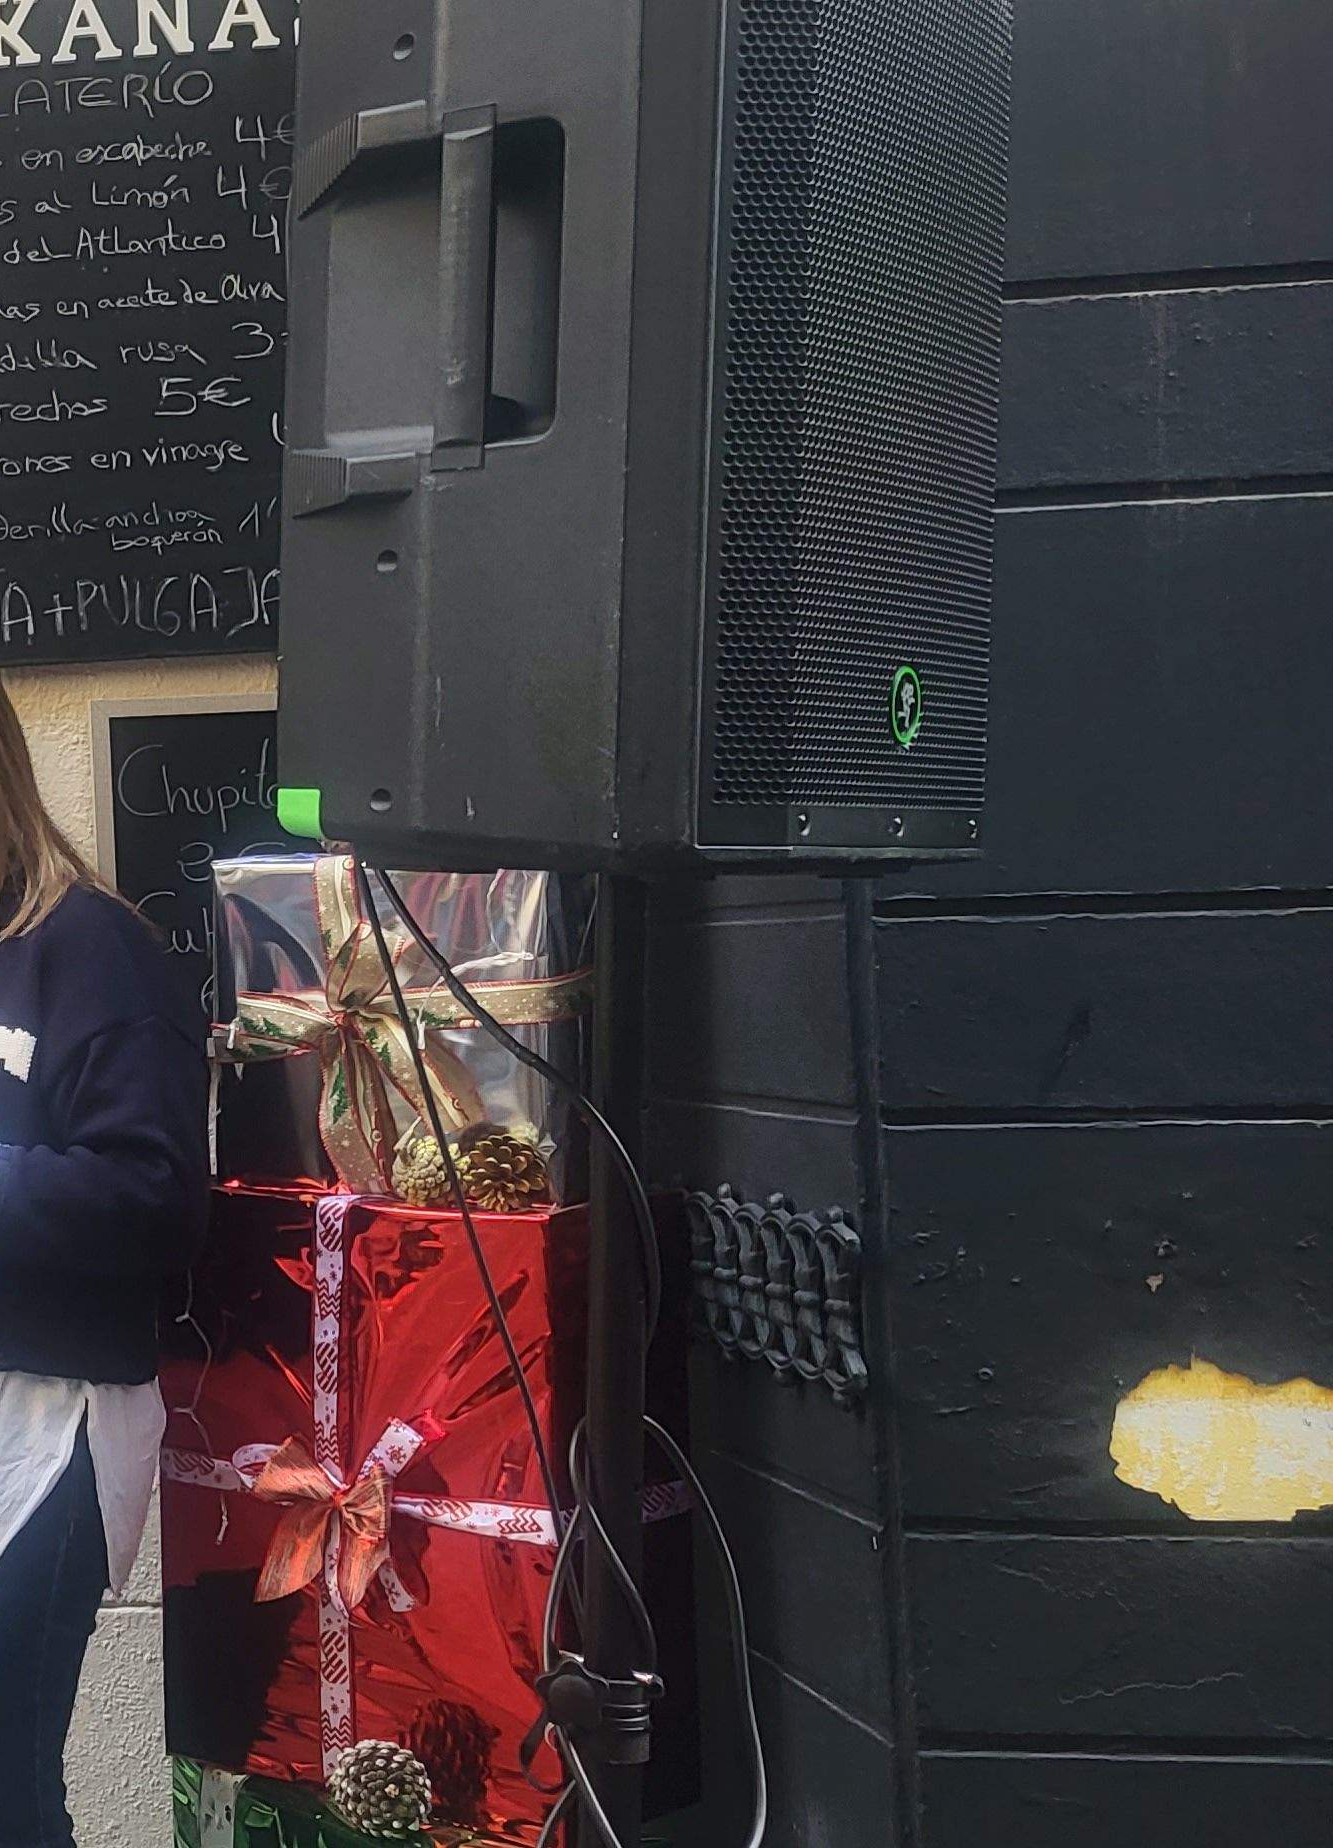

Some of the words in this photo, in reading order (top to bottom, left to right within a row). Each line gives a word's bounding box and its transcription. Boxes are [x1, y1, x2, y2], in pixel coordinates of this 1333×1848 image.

[22, 150, 64, 171] en
[75, 132, 212, 166] escabeche
[35, 190, 72, 214] al
[92, 174, 190, 208] Limón
[4, 237, 74, 265] del
[56, 296, 89, 320] en
[97, 277, 177, 309] aceite
[179, 278, 219, 304] de
[120, 341, 207, 366] rusa
[90, 450, 130, 470] en
[141, 437, 249, 473] vinagre
[111, 520, 224, 556] boquerón
